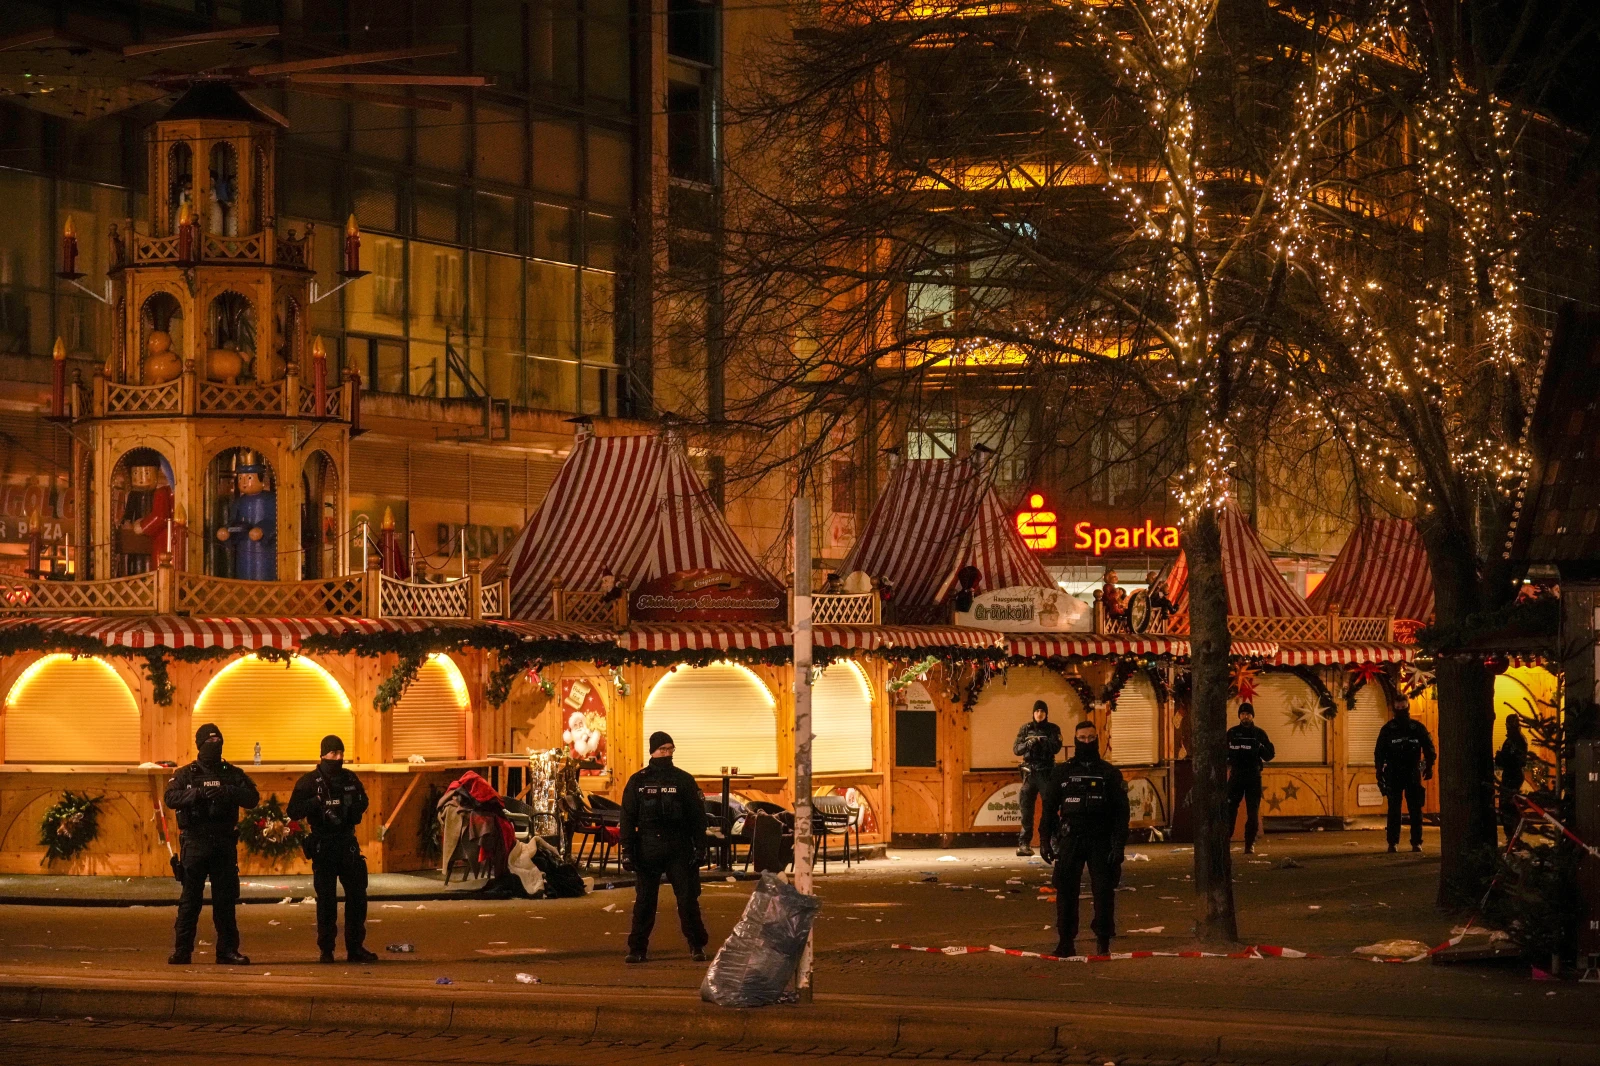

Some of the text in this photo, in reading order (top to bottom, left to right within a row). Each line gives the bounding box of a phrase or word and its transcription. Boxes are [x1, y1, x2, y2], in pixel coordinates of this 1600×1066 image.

[18, 521, 63, 540] PZA
[1074, 519, 1179, 556] Sparka
[693, 575, 723, 588] Original
[637, 594, 780, 613] Thüringer Rostbratwurst
[974, 604, 1035, 621] Grünkohl
